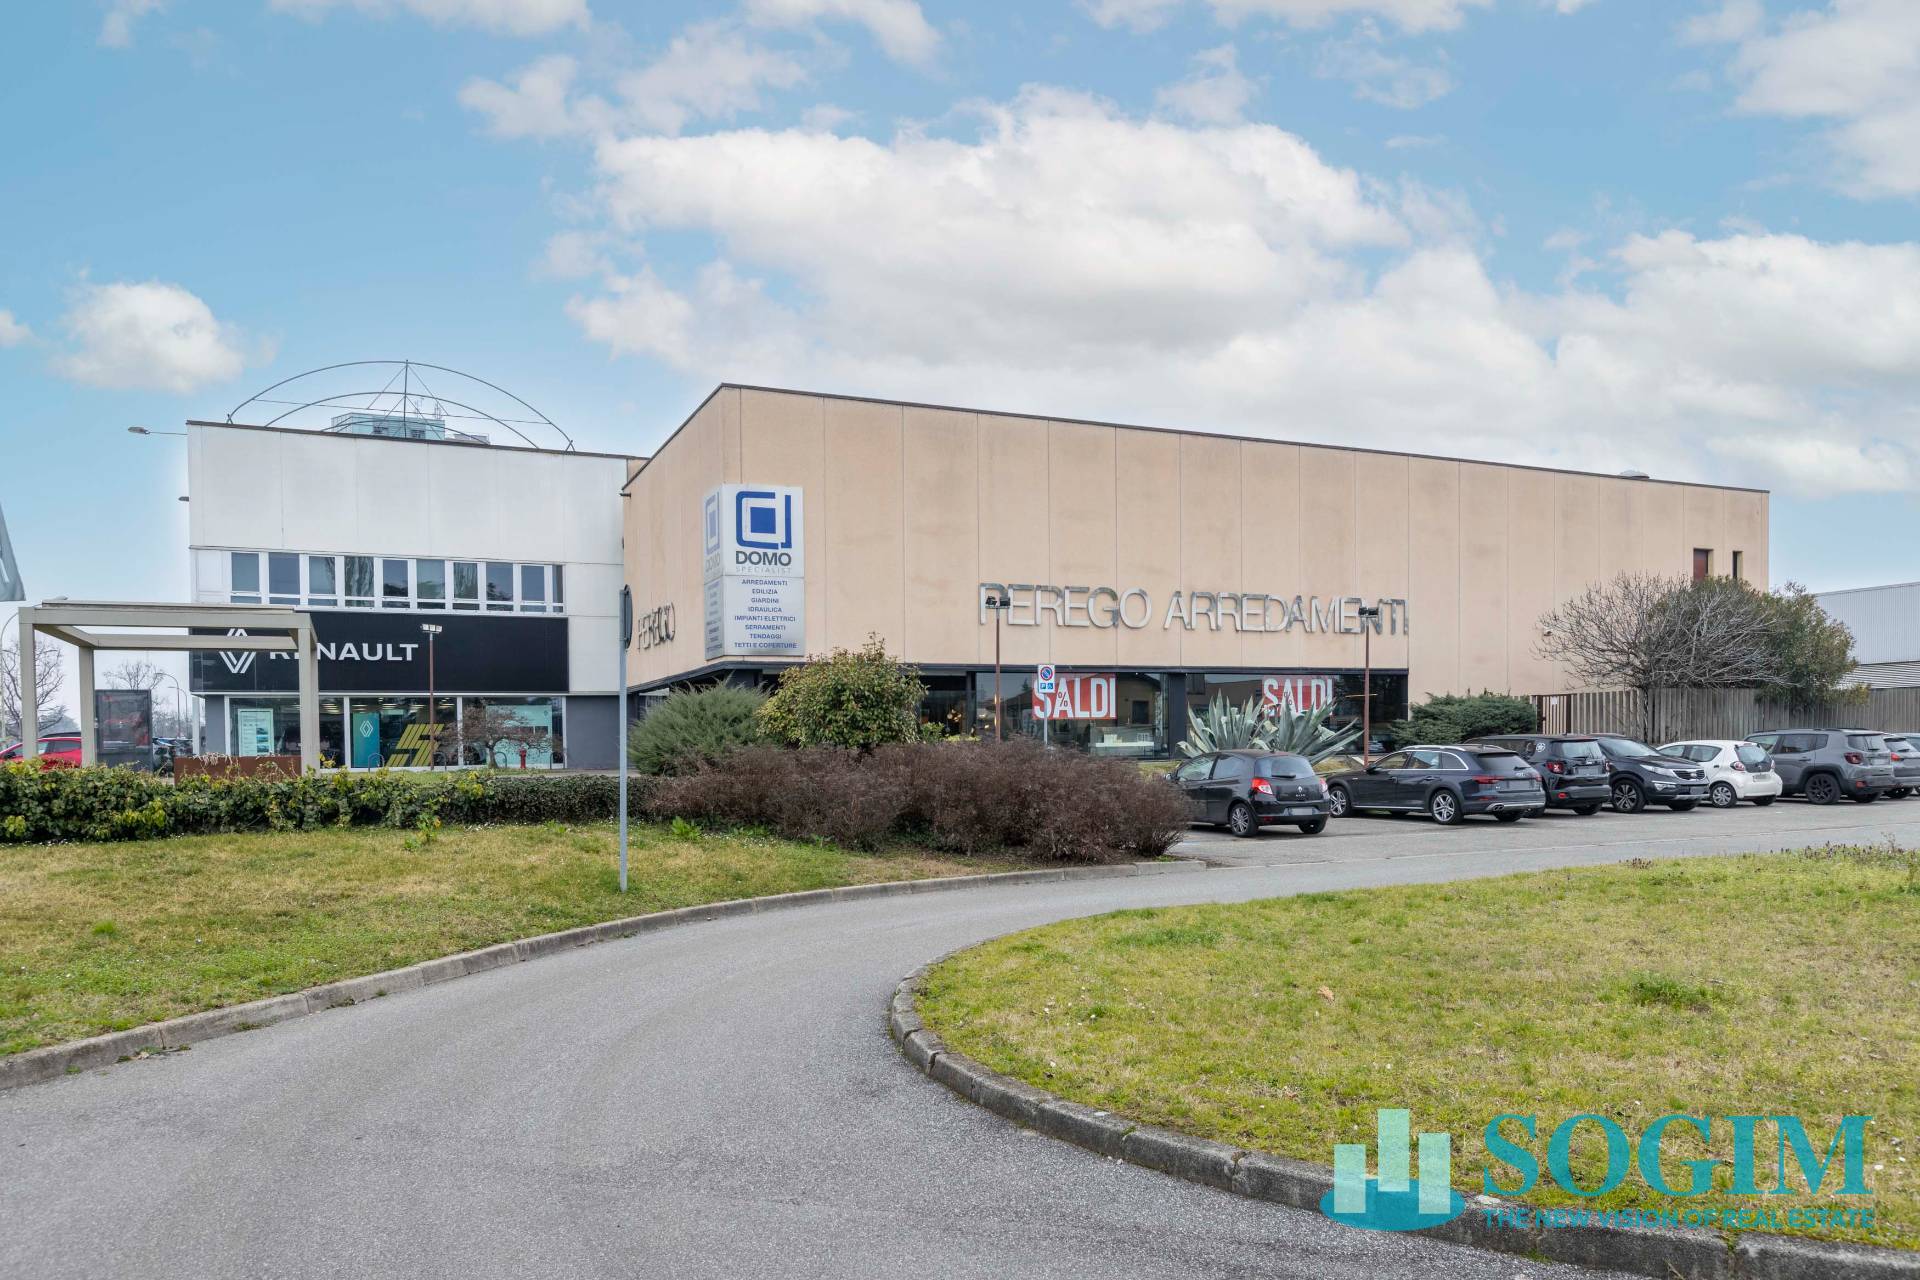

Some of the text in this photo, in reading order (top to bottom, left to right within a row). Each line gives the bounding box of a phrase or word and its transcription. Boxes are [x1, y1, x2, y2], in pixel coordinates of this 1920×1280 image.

[735, 550, 792, 567] DOMO
[735, 566, 792, 576] SPECIALIST
[980, 583, 1409, 636] PEREGO ARREDAMENTI
[269, 642, 419, 661] NAULT
[1033, 677, 1116, 719] SALDI
[1263, 678, 1333, 719] SALDI
